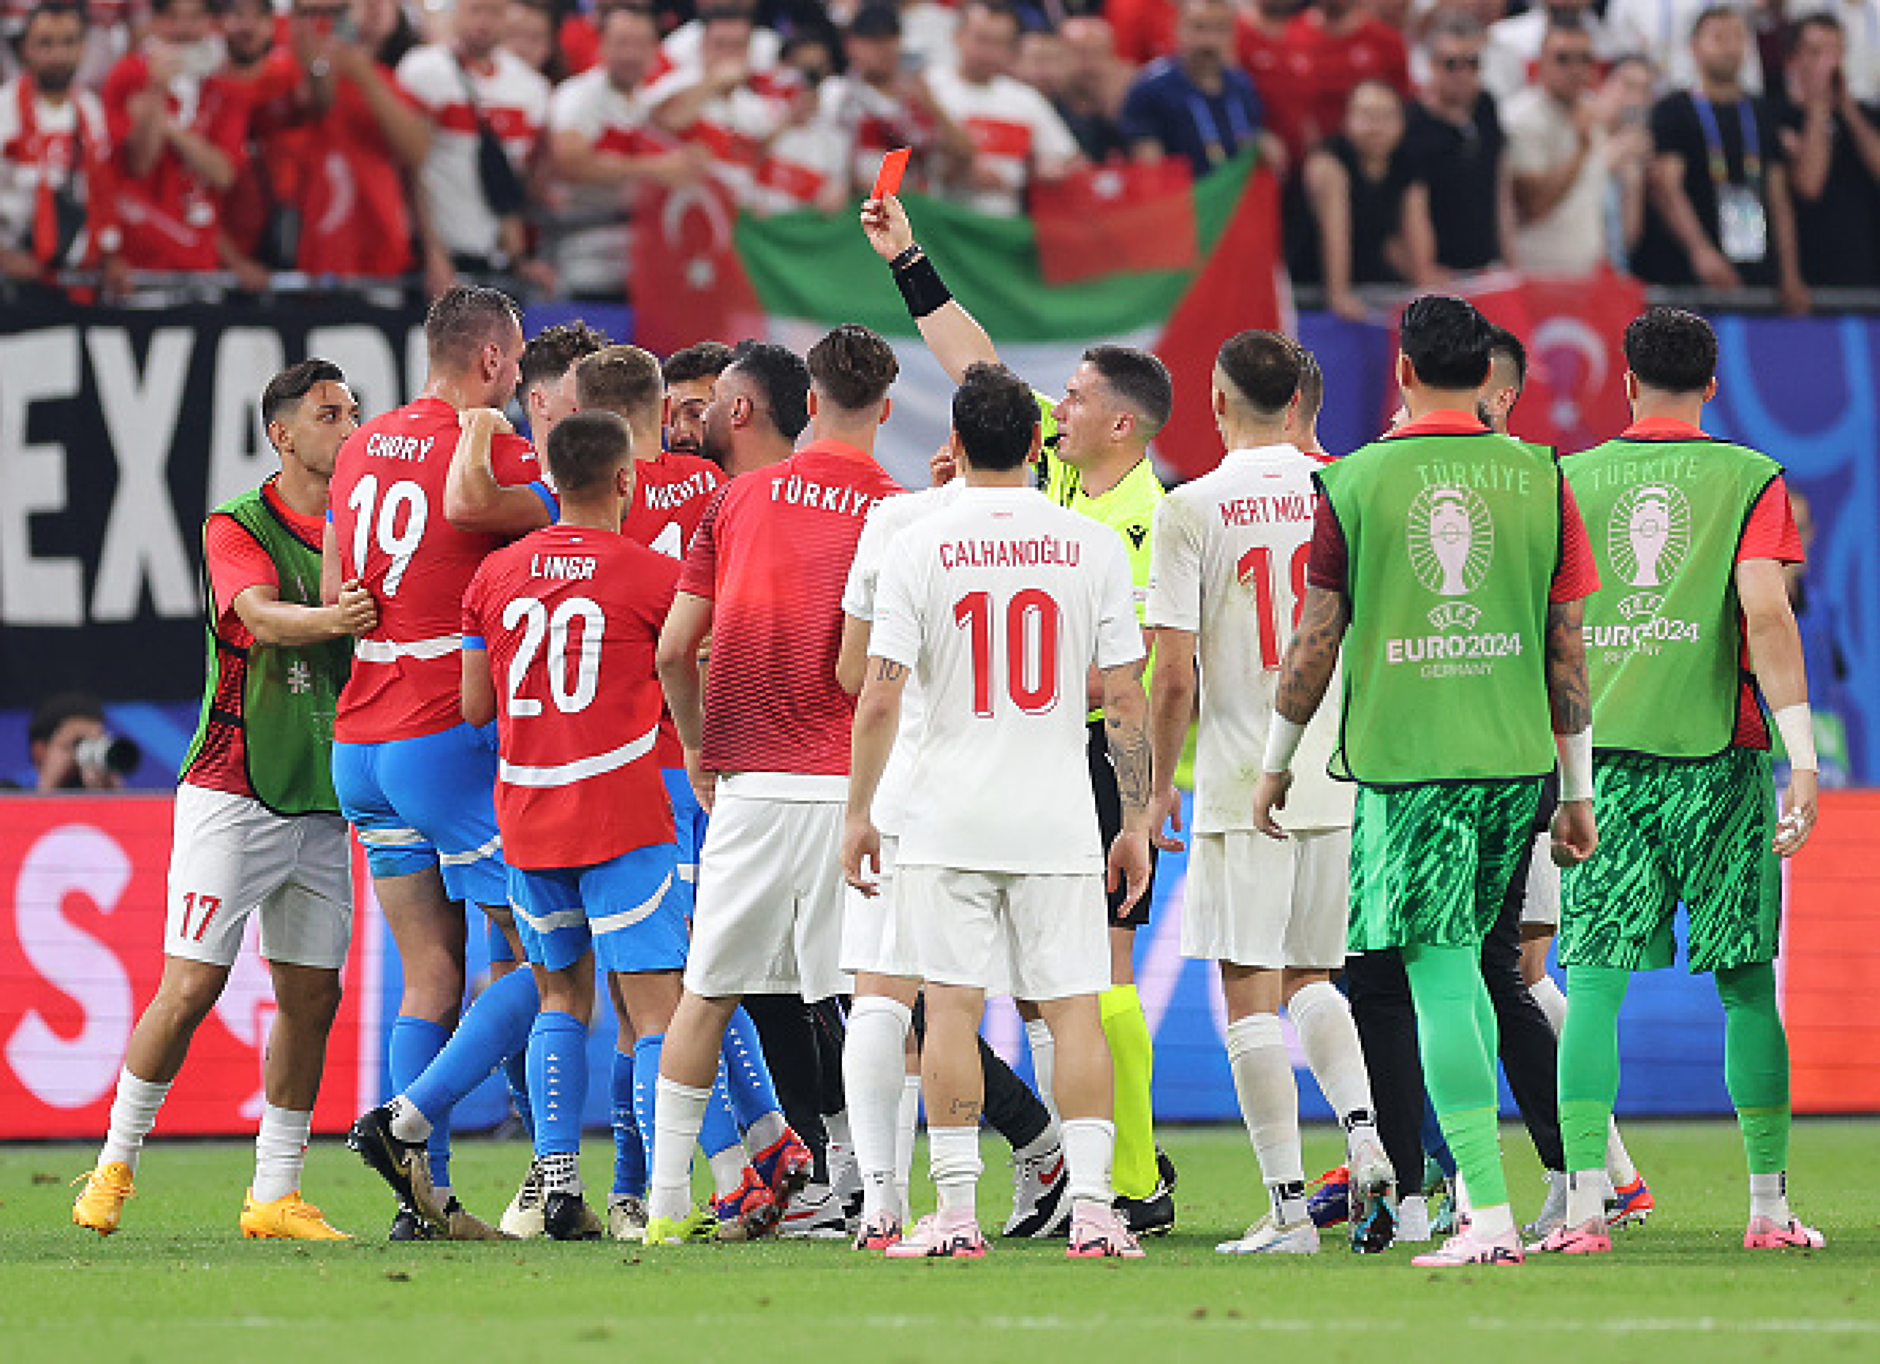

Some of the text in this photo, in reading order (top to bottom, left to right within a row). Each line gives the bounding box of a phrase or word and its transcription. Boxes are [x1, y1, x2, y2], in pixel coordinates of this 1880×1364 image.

[348, 473, 429, 598] 19
[939, 533, 1081, 572] ÇALHANOĞLU
[1219, 496, 1270, 528] MERT
[502, 597, 606, 717] 20
[953, 587, 1064, 719] 10
[181, 892, 222, 943] 17
